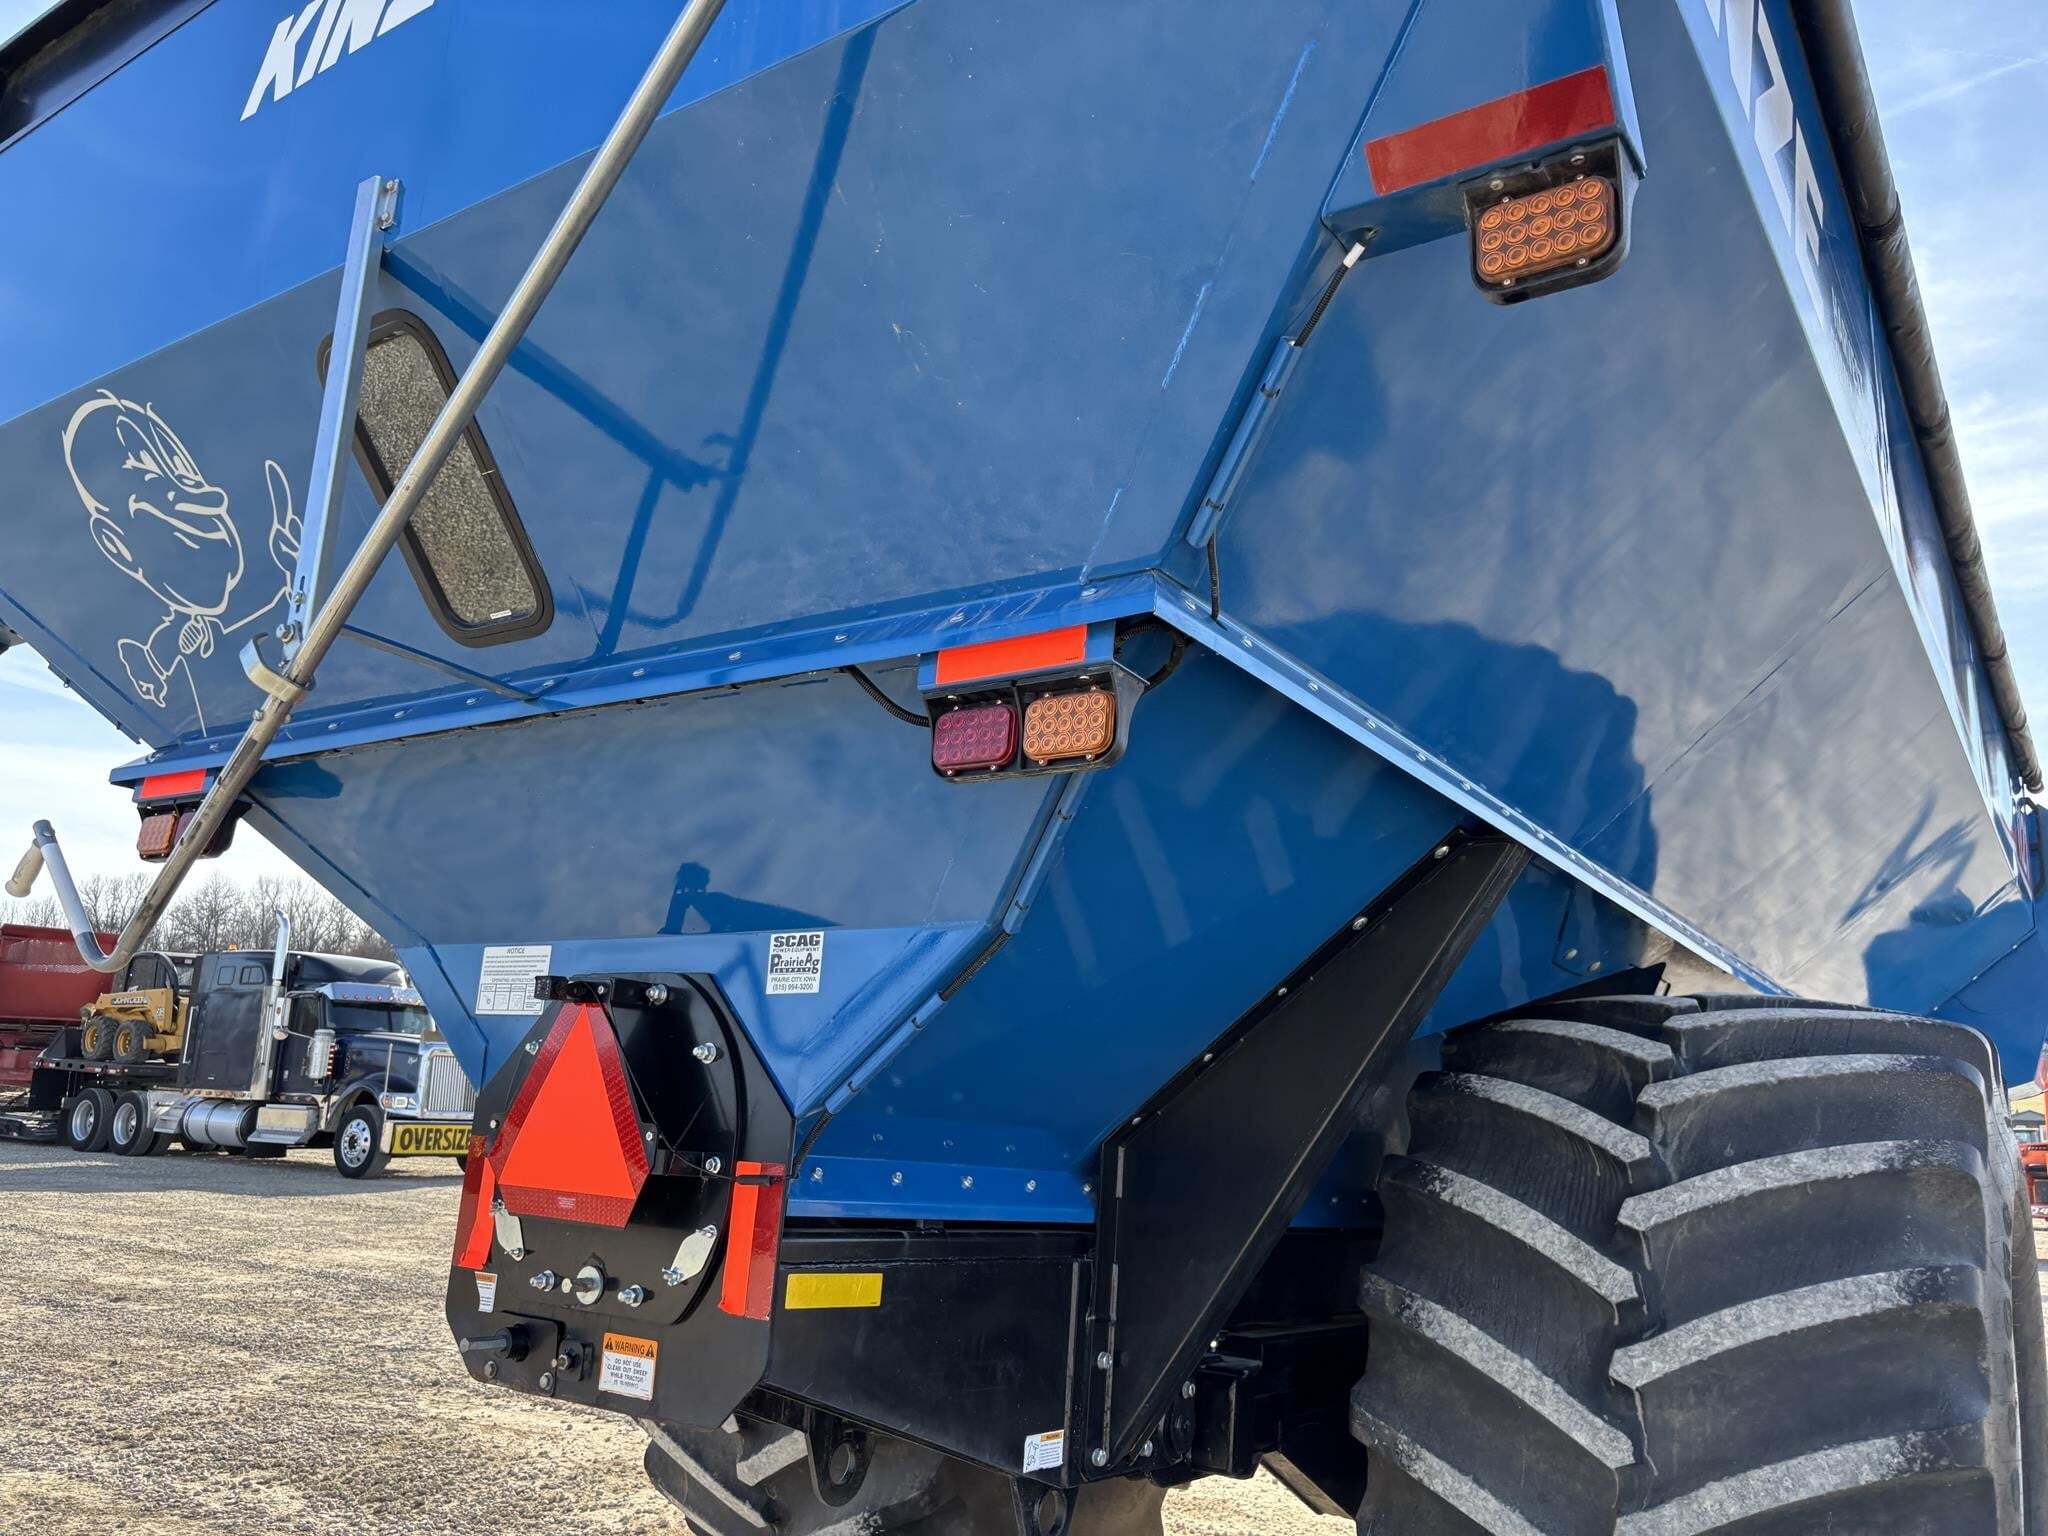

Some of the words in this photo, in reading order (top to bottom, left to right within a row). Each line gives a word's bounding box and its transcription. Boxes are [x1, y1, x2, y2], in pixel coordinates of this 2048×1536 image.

[773, 934, 820, 947] SCAG
[614, 1340, 645, 1354] WARNING
[607, 1363, 622, 1371] CLEAN
[610, 1371, 624, 1379] WHILE
[624, 1374, 644, 1383] TRACTOR
